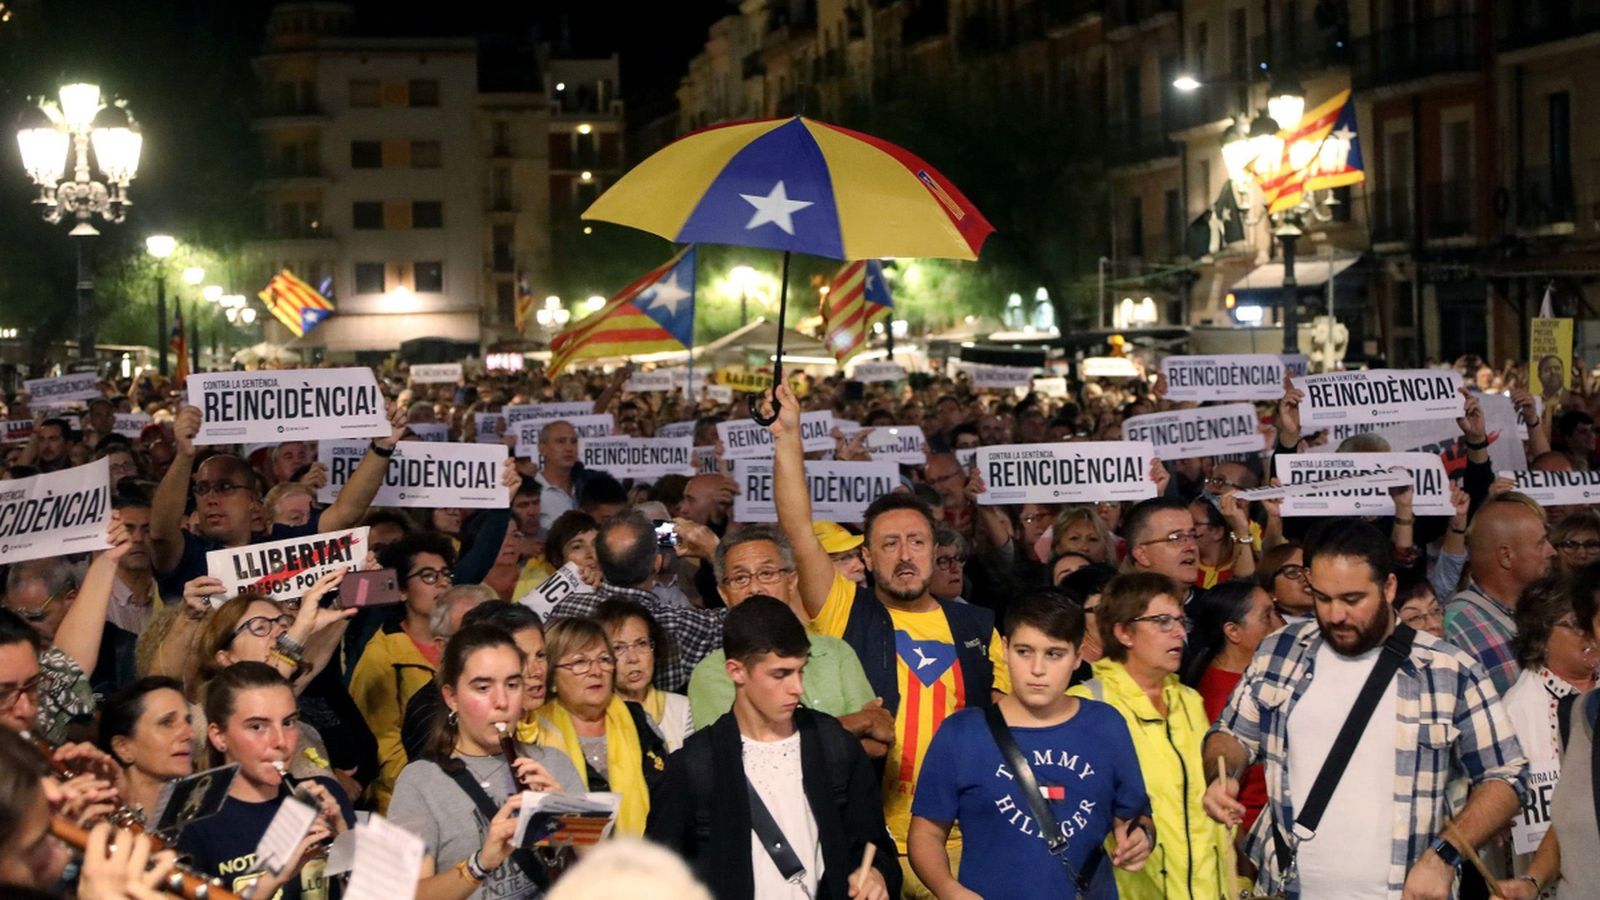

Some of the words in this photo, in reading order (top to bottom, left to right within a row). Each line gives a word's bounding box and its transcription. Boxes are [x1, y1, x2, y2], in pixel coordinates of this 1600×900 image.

[203, 380, 231, 391] CONTRA
[231, 379, 241, 390] LA
[725, 372, 799, 391] LLIBERT
[1168, 362, 1281, 387] REINCIDÈNCIA!
[204, 381, 377, 422] REINCIDÈNCIA!
[1308, 375, 1456, 408] REINCIDÈNCIA!
[728, 420, 828, 449] REINCICIA!
[1128, 415, 1254, 447] REINCIDÈNCIA!
[584, 443, 688, 466] REINCIDÈNCIA!
[989, 453, 1143, 488] REINCIDÈNCIA!
[331, 454, 496, 489] RECIDÈNCIA!
[746, 471, 891, 503] REIDÈNCIA!
[232, 535, 354, 580] LLIBERTAT
[994, 749, 1096, 781] TMMY
[994, 794, 1097, 838] HILGER
